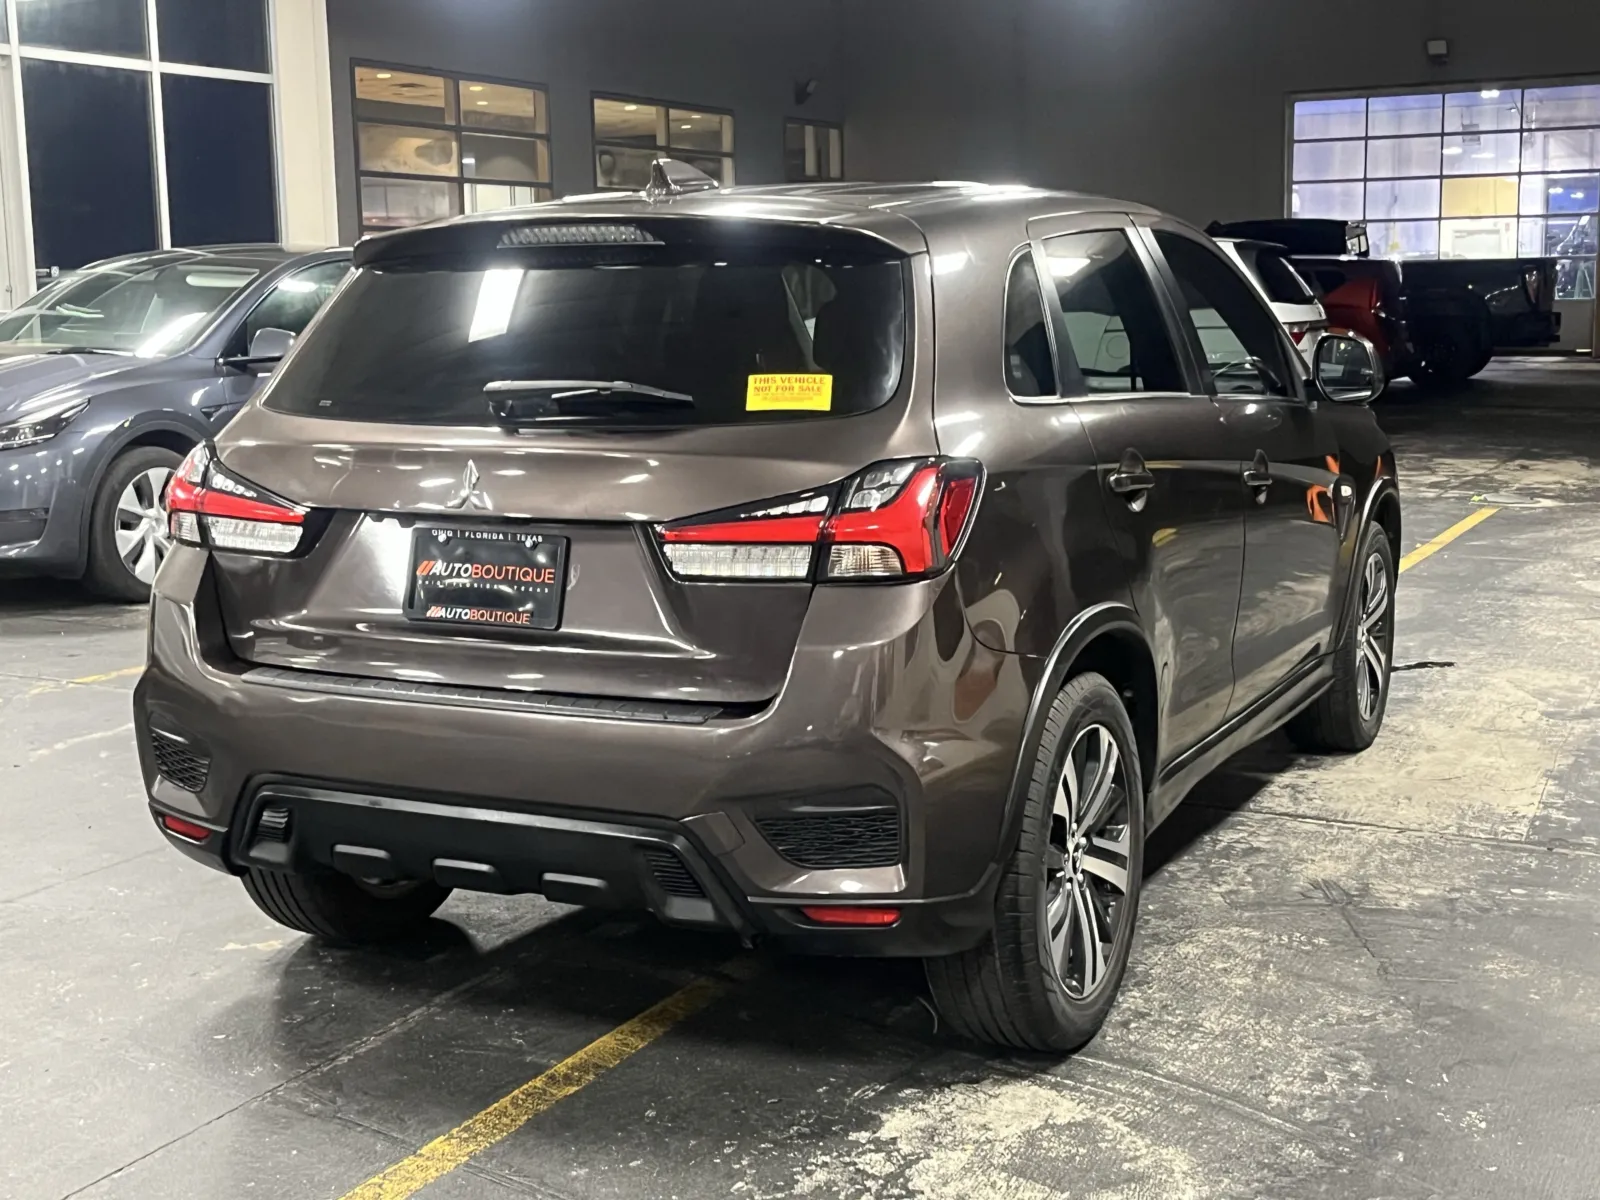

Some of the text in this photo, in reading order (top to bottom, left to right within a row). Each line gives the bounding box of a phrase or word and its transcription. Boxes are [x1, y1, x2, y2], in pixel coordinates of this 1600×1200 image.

[753, 376, 826, 385] THIS VEHICLE
[753, 385, 822, 393] NOT FOR SALE
[465, 531, 504, 540] FLORIDA
[516, 533, 543, 543] TEXAS
[428, 560, 556, 584] AUTOBOUTIQUE
[437, 606, 531, 625] AUTOBOUTIQUE
